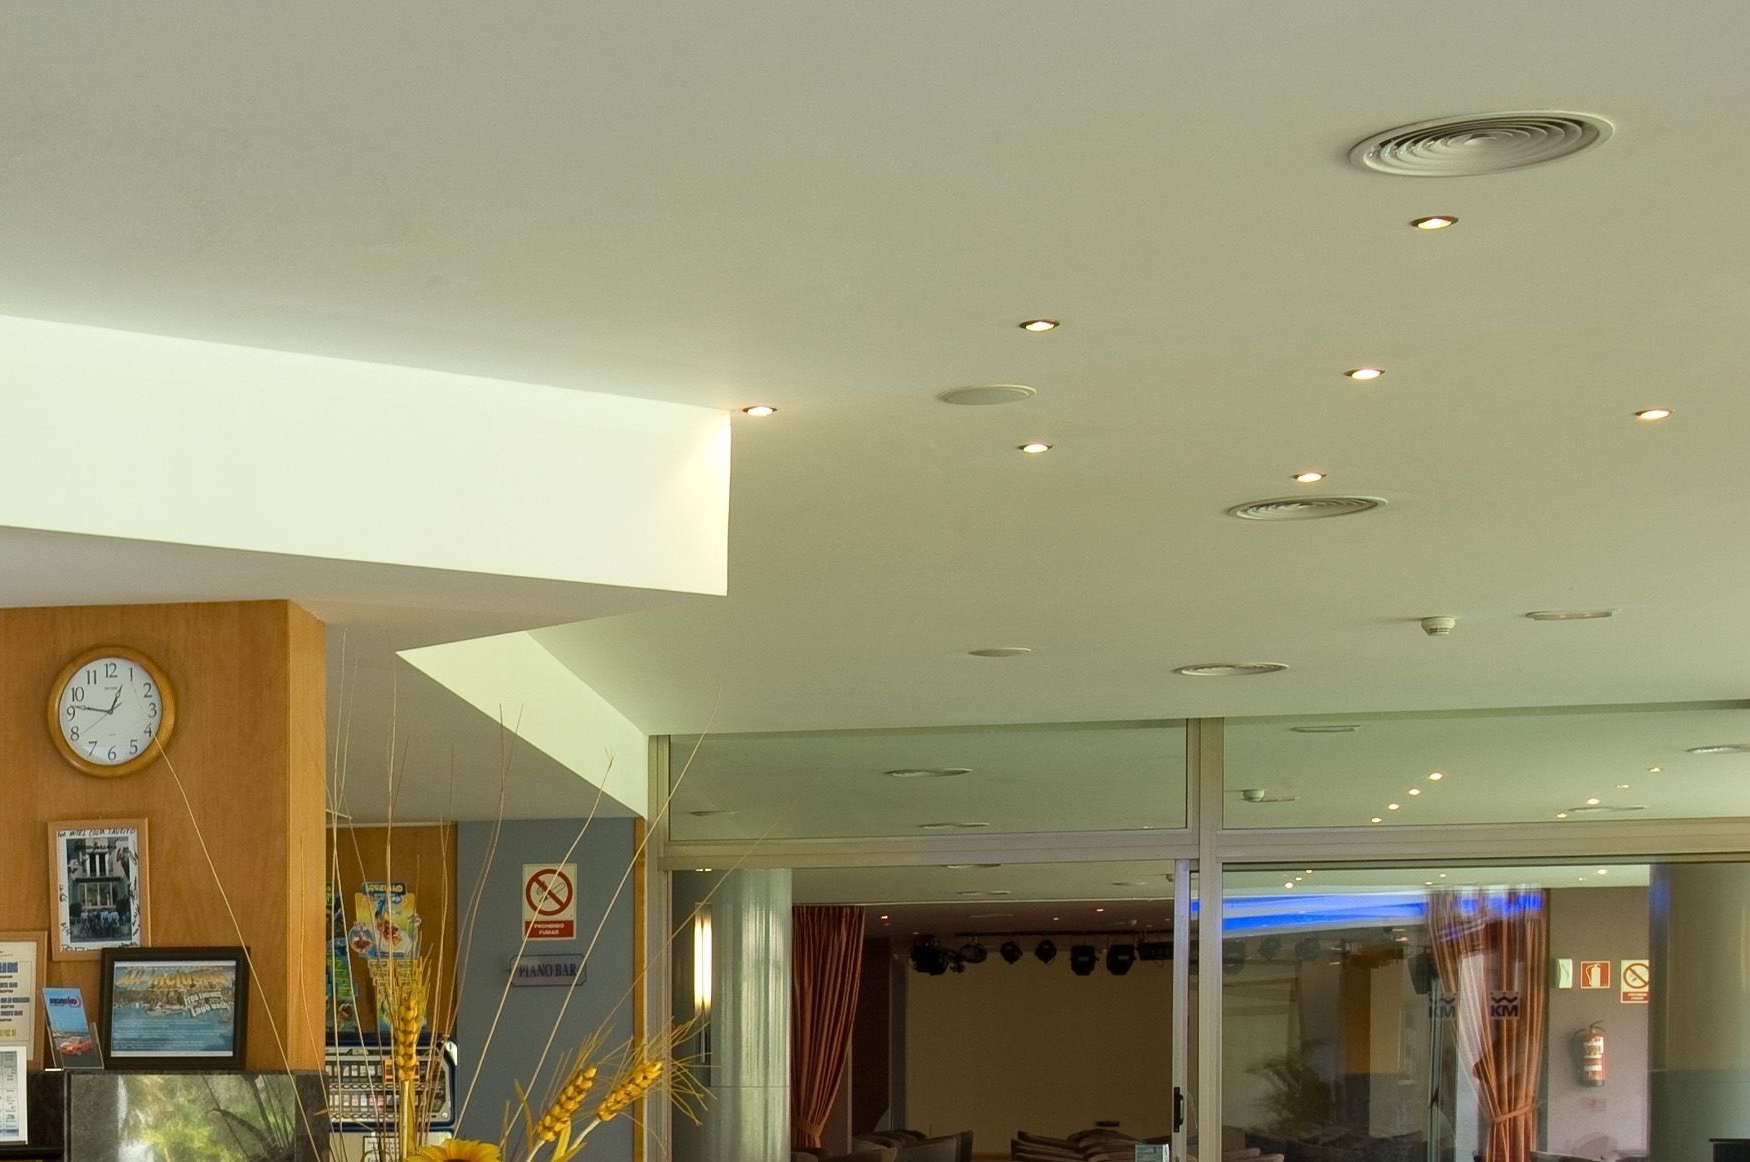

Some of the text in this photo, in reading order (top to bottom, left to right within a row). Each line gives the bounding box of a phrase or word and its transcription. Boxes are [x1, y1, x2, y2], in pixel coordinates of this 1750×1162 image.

[86, 670, 97, 685] 11
[105, 663, 118, 678] 12
[71, 687, 84, 702] 10
[143, 682, 153, 698] 2
[66, 705, 76, 721] 9
[148, 702, 157, 718] 3
[70, 726, 80, 741] 8
[144, 722, 152, 737] 4
[88, 740, 97, 756] 7
[107, 745, 117, 761] 6
[130, 739, 138, 755] 5
[519, 963, 577, 978] PIANO BAR
[1429, 1005, 1456, 1018] KM
[1491, 1004, 1518, 1017] KM
